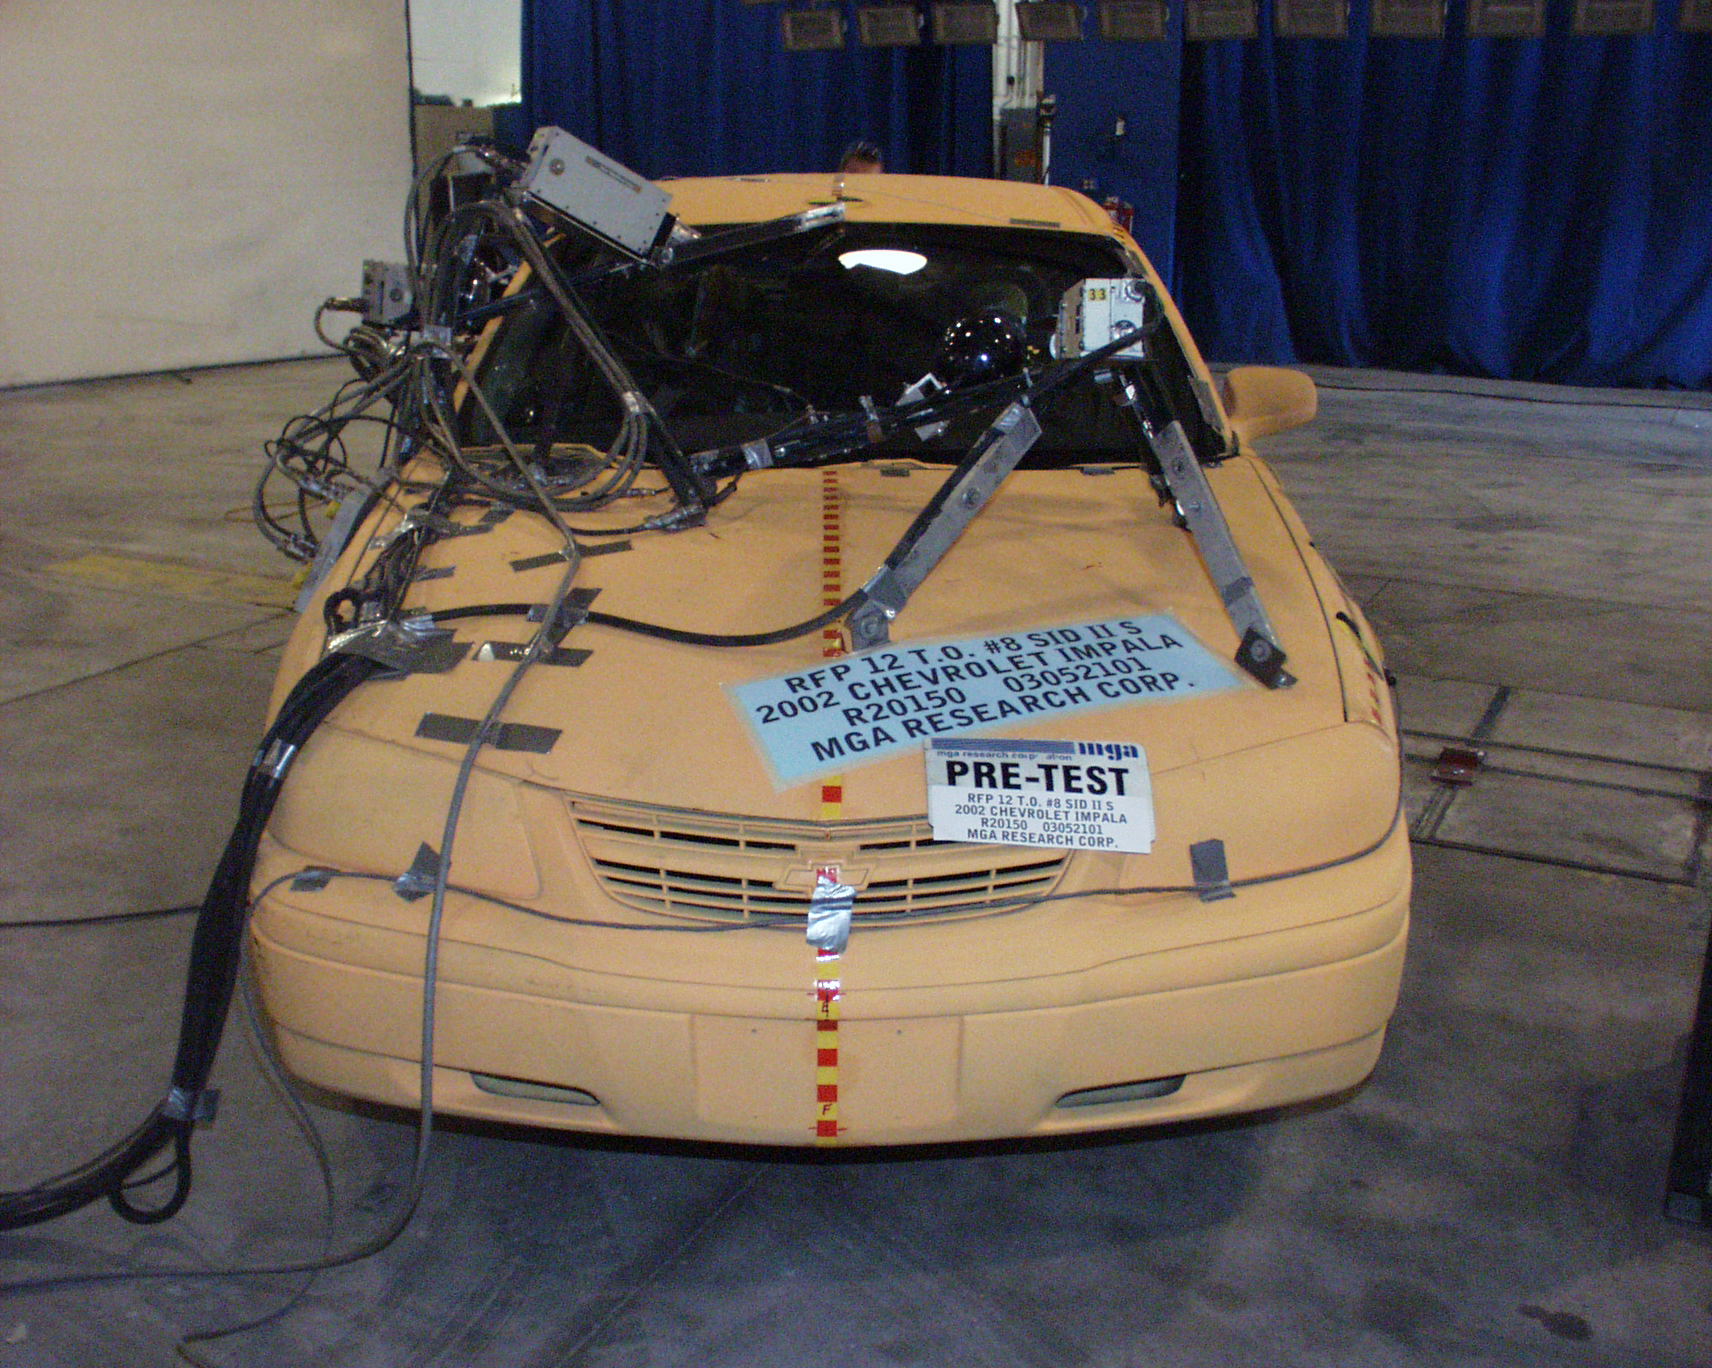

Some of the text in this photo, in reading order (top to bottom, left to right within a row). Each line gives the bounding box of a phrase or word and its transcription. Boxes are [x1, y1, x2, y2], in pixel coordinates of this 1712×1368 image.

[1088, 288, 1106, 300] 33
[784, 620, 1142, 694] RFP 12 T.O. #8 SID II S
[755, 633, 1184, 724] 2002 CHEVROLET IMPALA
[842, 656, 1152, 727] R20150 03052101
[810, 671, 1195, 762] MGA RESEARCH CORP.
[1078, 742, 1139, 761] mga
[946, 760, 1129, 796] PRE-TEST
[967, 793, 994, 805] RFP
[998, 794, 1013, 806] 12
[1018, 795, 1042, 807] T.O.
[1046, 796, 1061, 809] #8
[1066, 798, 1088, 810] SID
[1106, 801, 1114, 811] S
[955, 804, 1127, 824] 2002 CHEVROLET IMPALA
[981, 818, 1103, 835] R20150 03052101
[967, 828, 1119, 849] MGA RESEARCH CORP.
